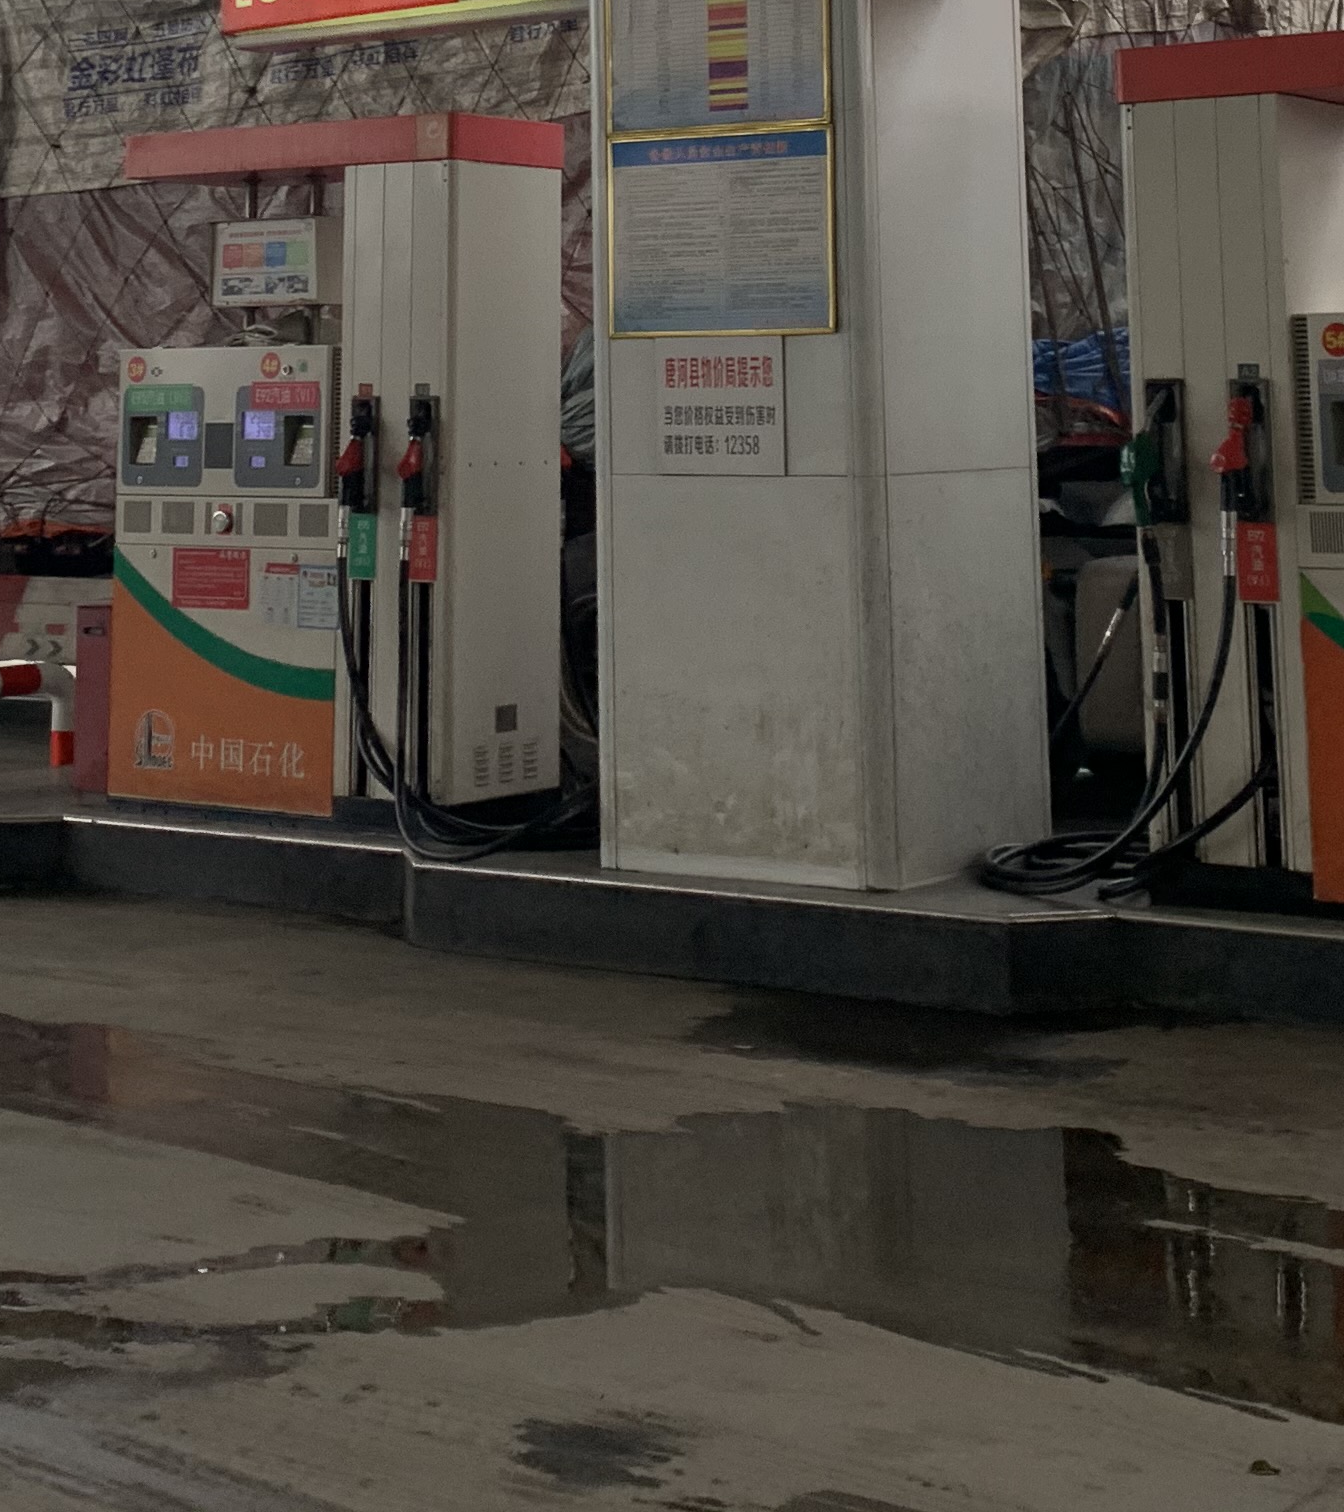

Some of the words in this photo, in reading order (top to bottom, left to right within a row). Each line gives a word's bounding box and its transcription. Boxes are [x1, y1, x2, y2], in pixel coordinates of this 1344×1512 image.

[665, 355, 774, 389] 唐河县物价局提示您
[664, 405, 776, 426] 当您价格权益受到伤害时
[191, 734, 305, 779] 中国石化
